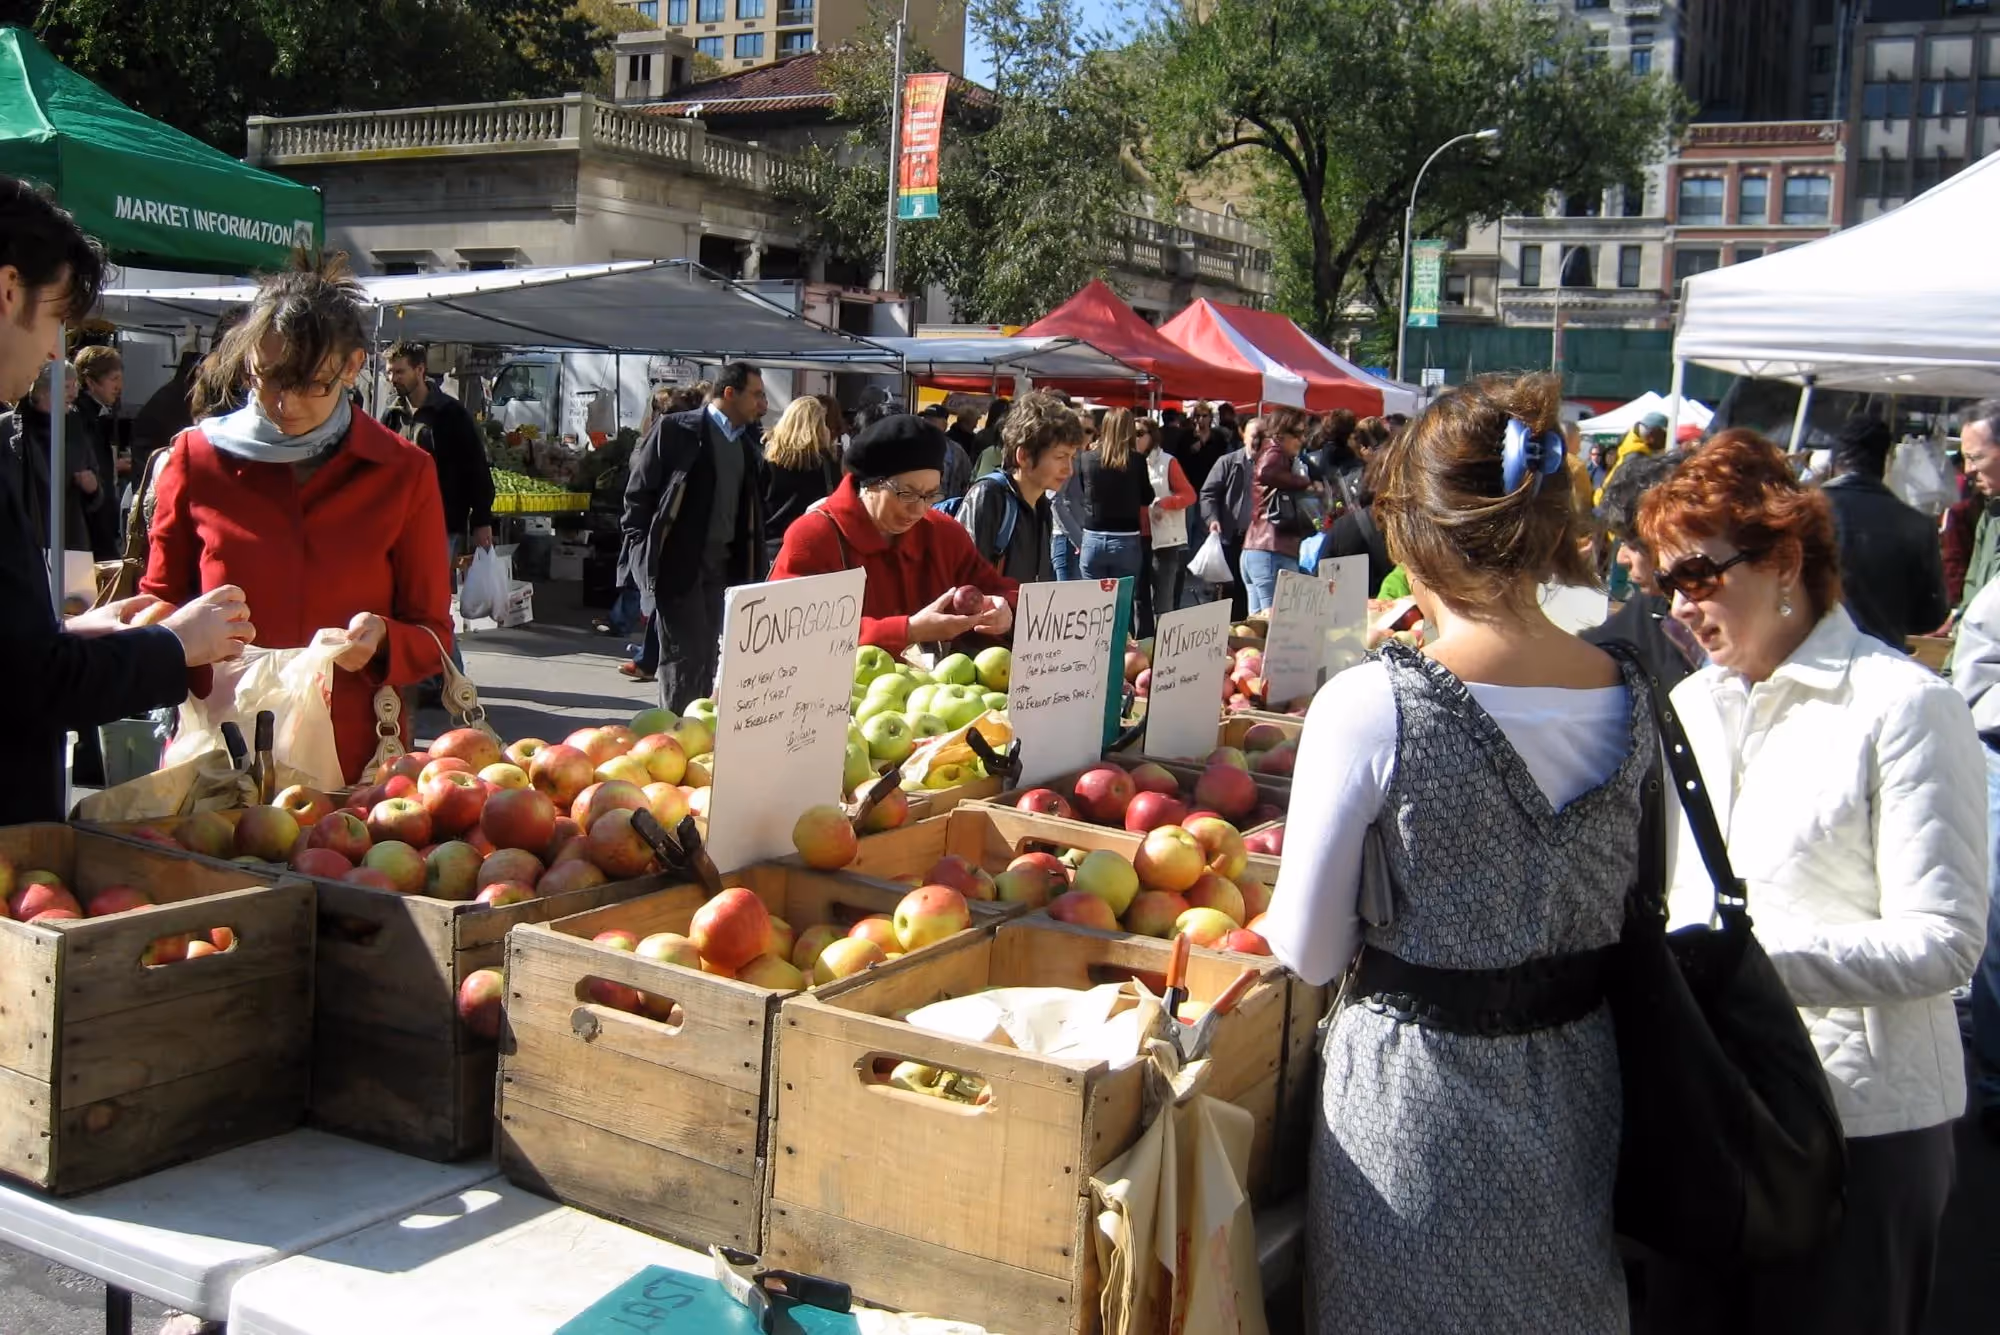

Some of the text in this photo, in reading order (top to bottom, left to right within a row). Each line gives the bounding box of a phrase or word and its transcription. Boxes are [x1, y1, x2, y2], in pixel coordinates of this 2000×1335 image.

[115, 195, 294, 247] MARKET INFORMATION
[739, 594, 857, 654] JONAGOLD
[1025, 589, 1115, 643] WINESAP
